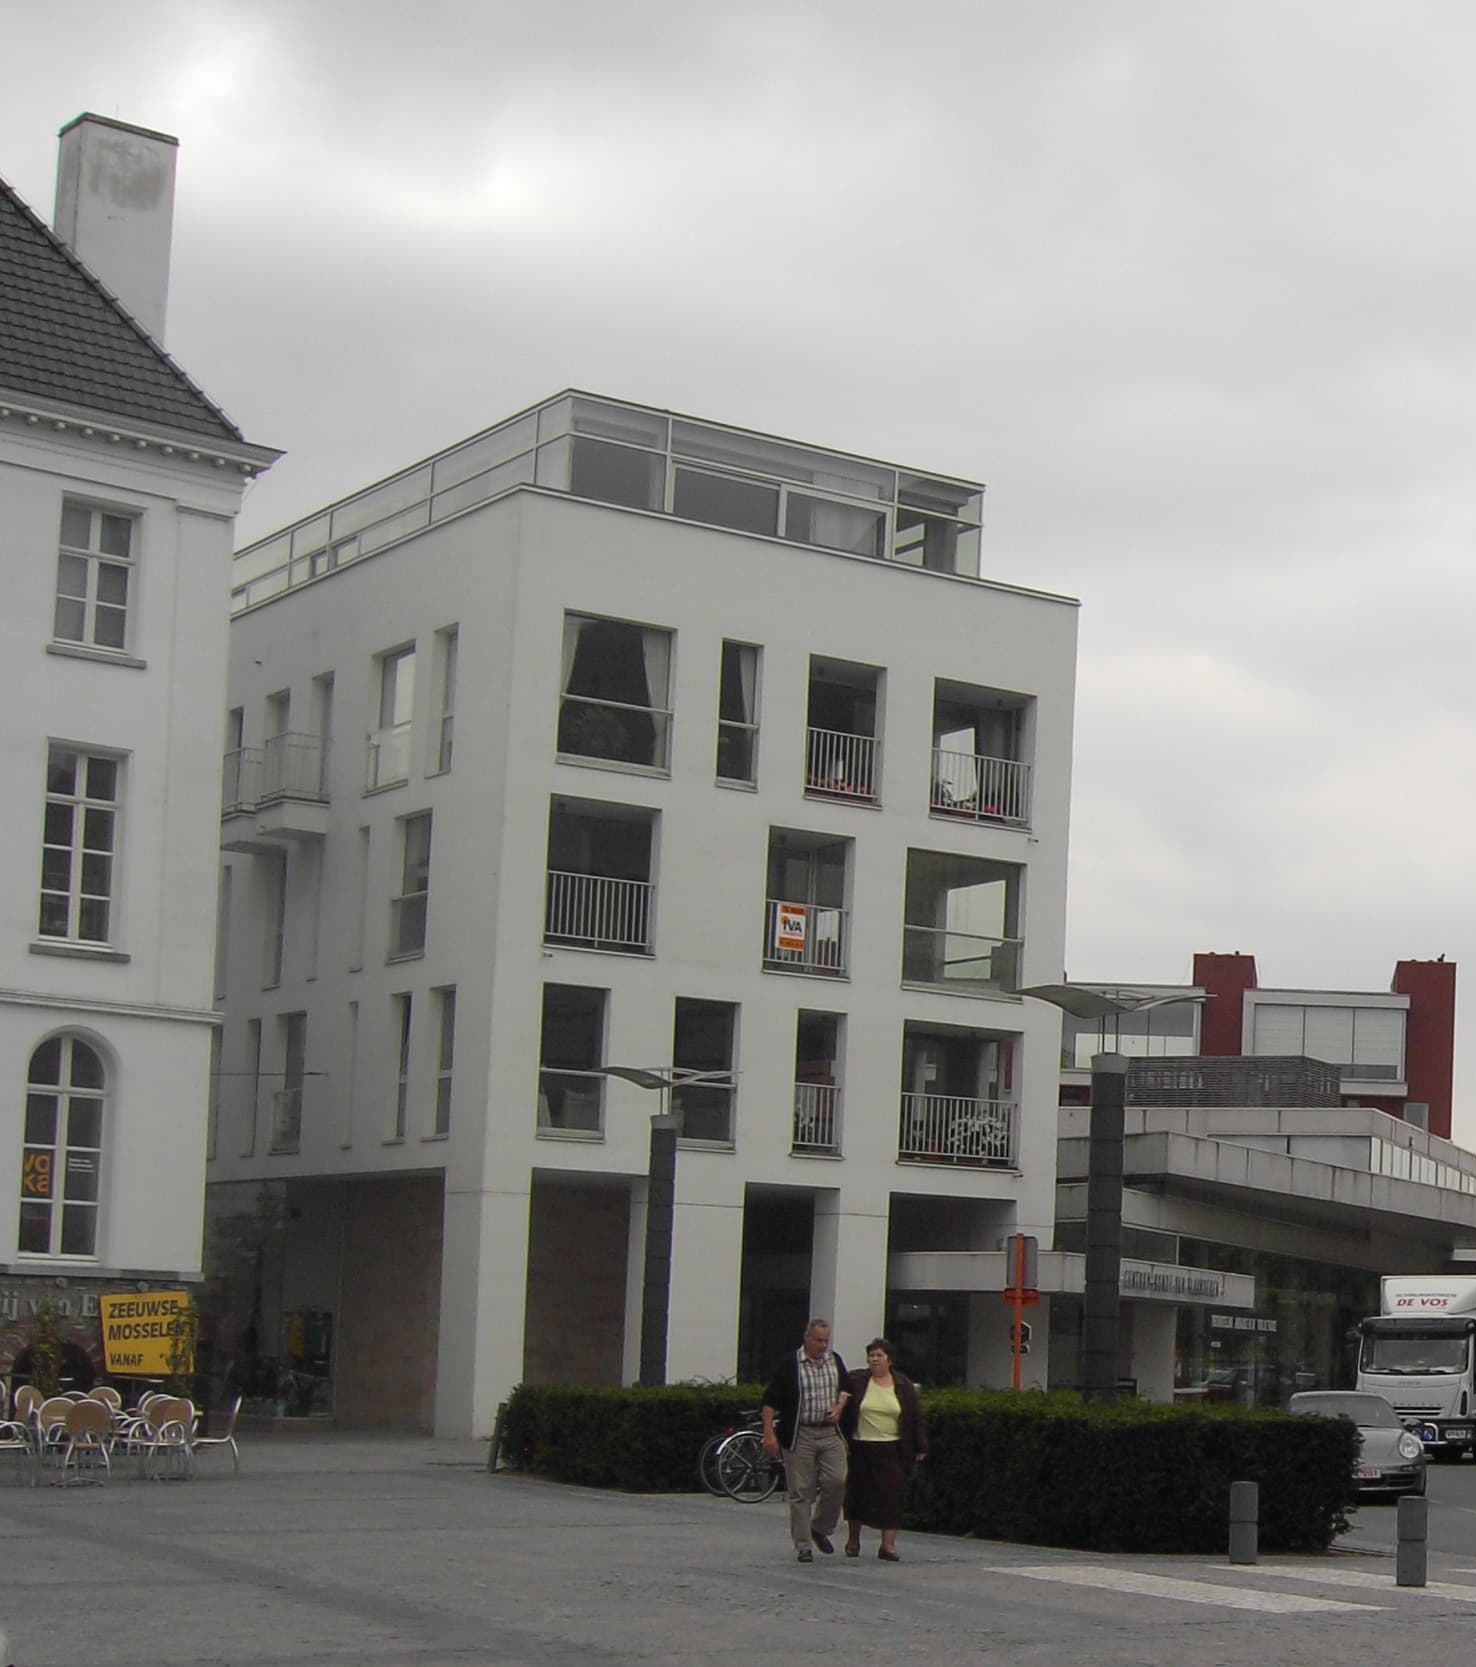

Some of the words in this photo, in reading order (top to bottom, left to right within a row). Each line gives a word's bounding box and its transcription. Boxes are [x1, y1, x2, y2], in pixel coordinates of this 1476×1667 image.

[108, 1299, 179, 1319] ZEEUWSE
[1396, 1298, 1414, 1307] DE
[1420, 1298, 1449, 1307] VOS
[109, 1353, 145, 1367] VANAF
